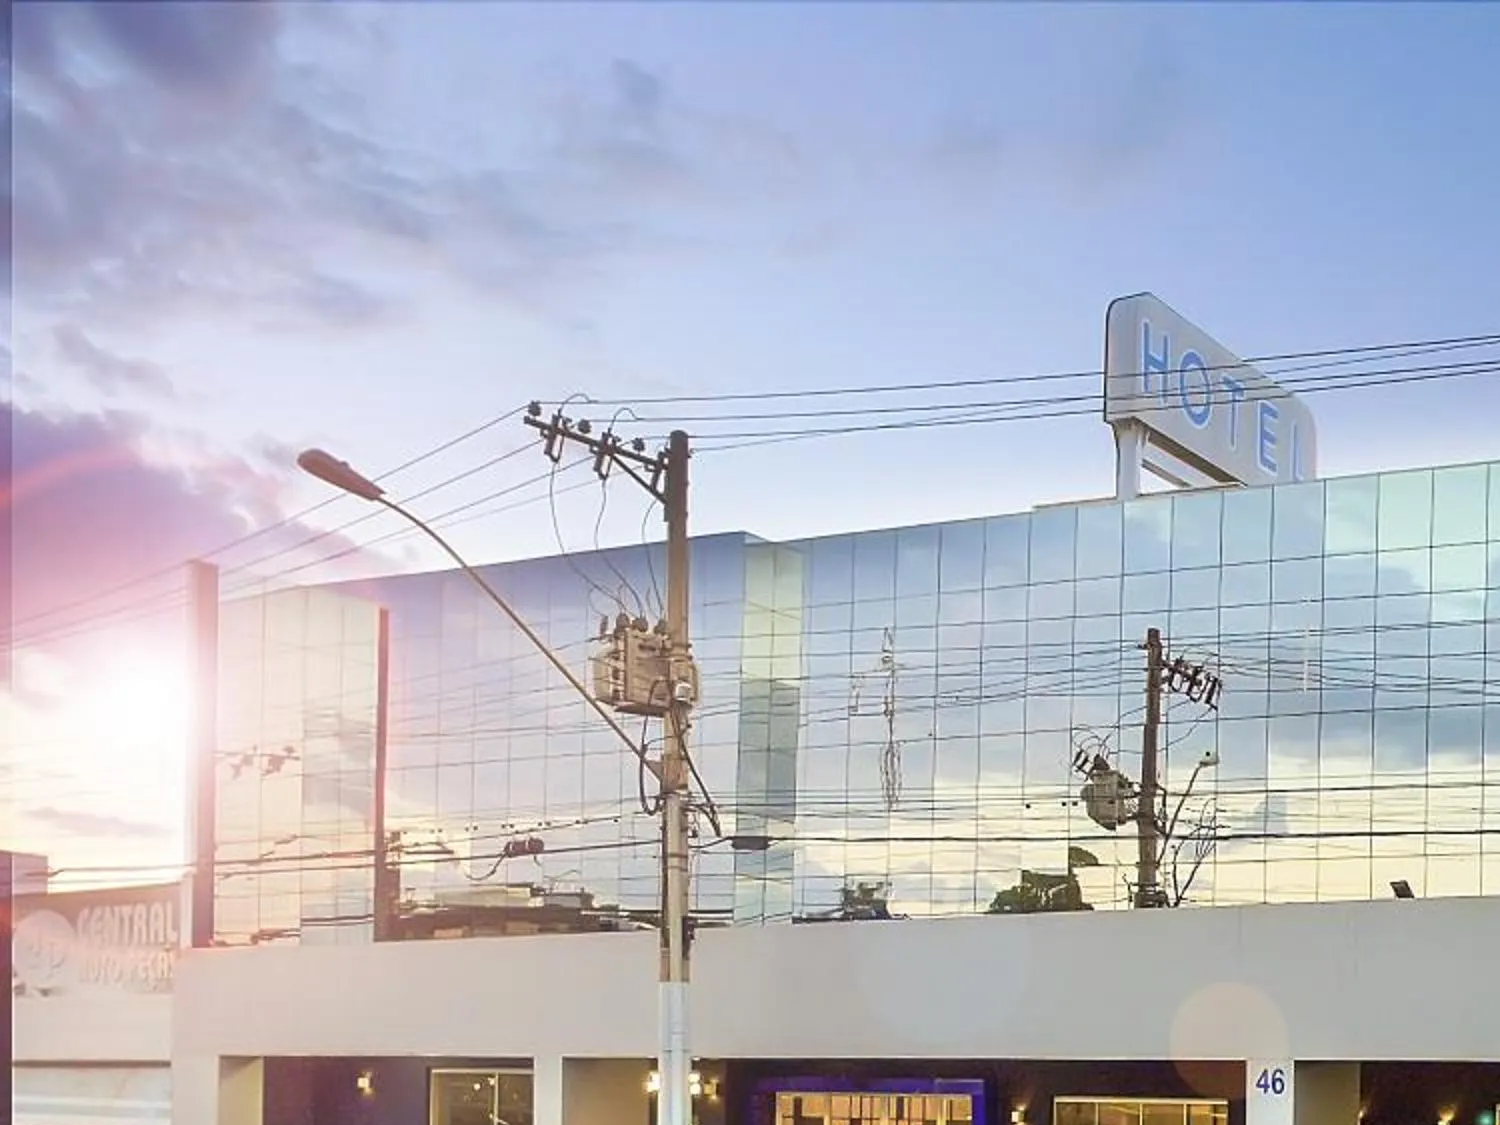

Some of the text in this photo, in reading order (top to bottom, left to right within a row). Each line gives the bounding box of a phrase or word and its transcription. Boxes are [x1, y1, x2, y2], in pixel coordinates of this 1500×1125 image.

[1142, 319, 1303, 482] HOTEL
[77, 900, 178, 946] CENTRAL
[1255, 1068, 1285, 1095] 46
